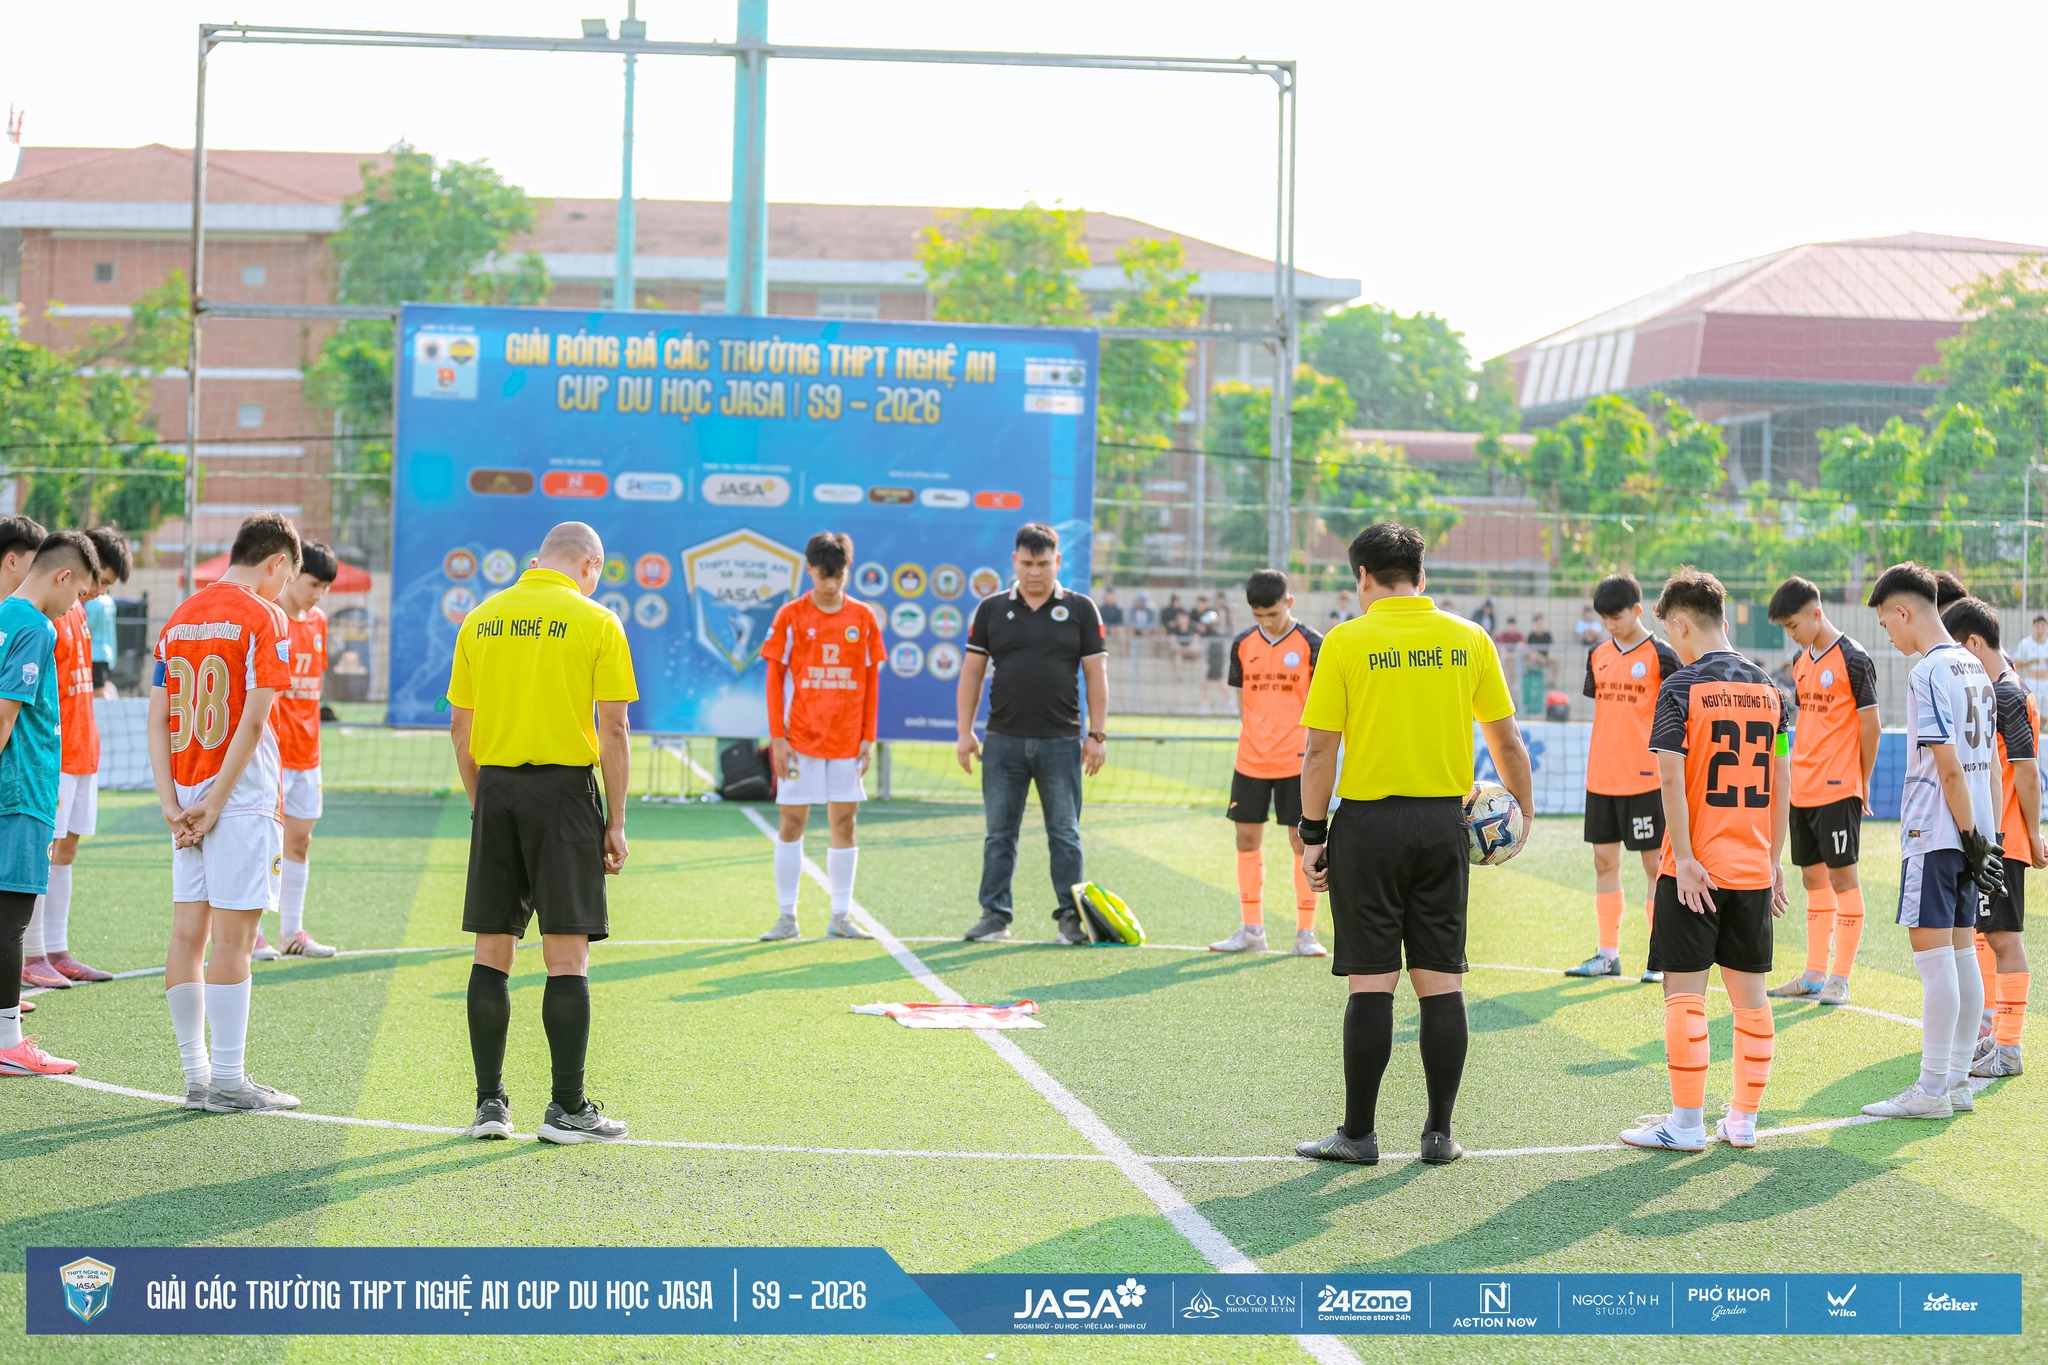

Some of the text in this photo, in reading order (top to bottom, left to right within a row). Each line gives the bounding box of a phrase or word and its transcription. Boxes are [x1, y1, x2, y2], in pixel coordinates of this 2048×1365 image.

[505, 326, 997, 389] GIẢI BÓNG ĐÁ CÁC TRƯỜNG THPT NGHỆ AN
[557, 374, 609, 411] CUP
[617, 375, 653, 413] DU
[660, 377, 713, 423] HỌC
[720, 379, 786, 418] JASA
[808, 383, 842, 419] S9
[875, 386, 941, 424] 2026
[717, 482, 765, 496] JASA
[715, 588, 760, 601] JASA
[477, 616, 568, 639] PHỦI NGHỆ AN
[295, 652, 313, 674] 77
[822, 643, 841, 664] 12
[1368, 646, 1467, 671] PHỦI NGHỆ AN
[167, 654, 230, 753] 38
[1701, 689, 1732, 709] NGUYỄN
[1733, 692, 1761, 709] TRƯỜNG
[1964, 685, 1997, 750] 53
[1706, 720, 1774, 808] 23
[1632, 816, 1654, 840] 25
[1832, 829, 1848, 854] 17
